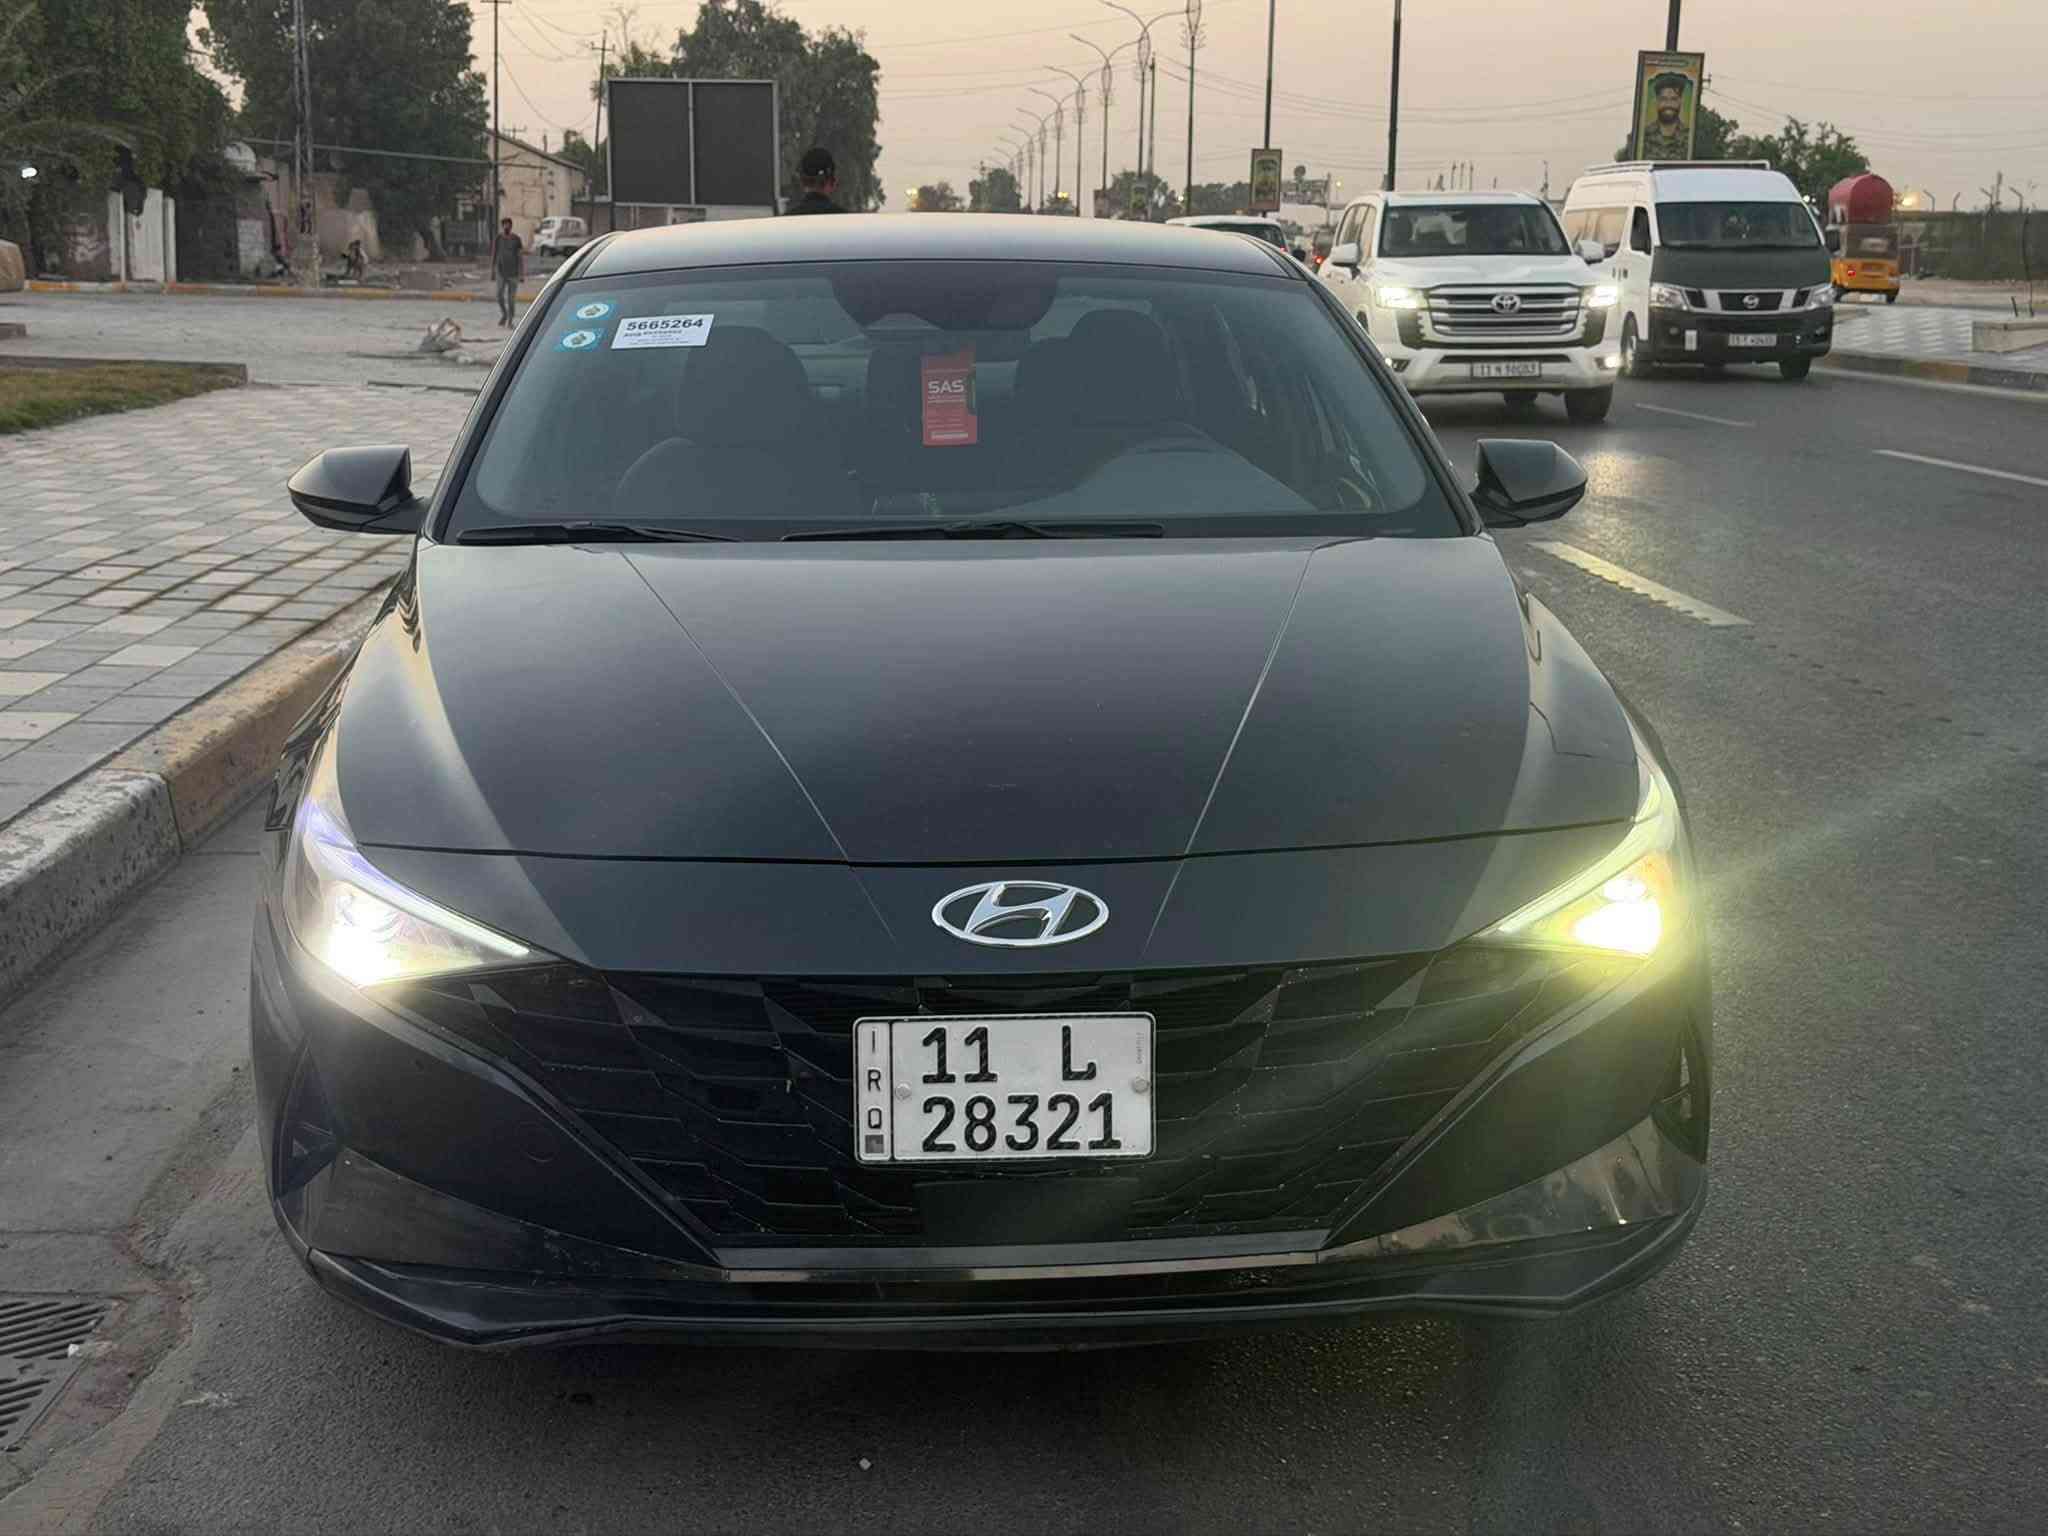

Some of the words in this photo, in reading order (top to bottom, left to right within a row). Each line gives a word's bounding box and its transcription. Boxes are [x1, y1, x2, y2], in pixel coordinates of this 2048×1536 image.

[626, 318, 704, 331] 5665264
[928, 379, 965, 394] SAS
[922, 1026, 998, 1084] 11
[1062, 1025, 1097, 1081] L
[922, 1093, 1121, 1152] 28321
